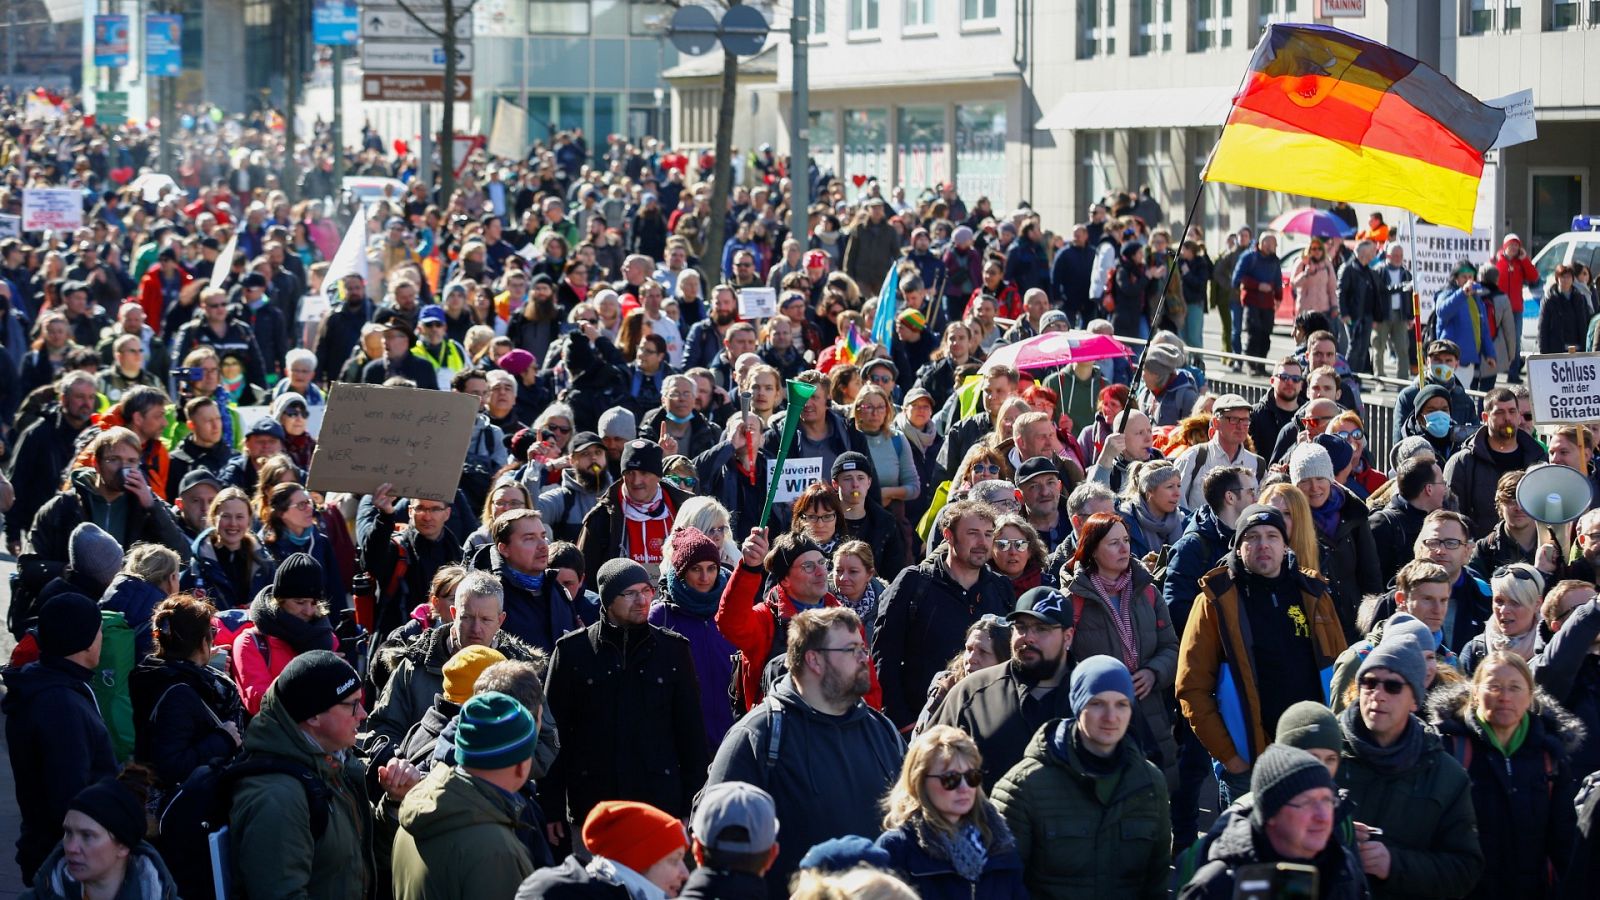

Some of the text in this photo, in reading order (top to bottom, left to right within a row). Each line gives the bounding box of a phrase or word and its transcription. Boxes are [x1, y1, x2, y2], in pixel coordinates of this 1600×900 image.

[1325, 0, 1362, 10] TRAINING
[1416, 236, 1428, 244] DIE
[1429, 237, 1491, 251] FREIHEIT
[1416, 250, 1452, 260] AUFGIBT
[1551, 361, 1596, 383] Schluss
[1561, 383, 1590, 394] mit der
[1549, 394, 1600, 407] Corona
[1550, 406, 1600, 419] Diktatu
